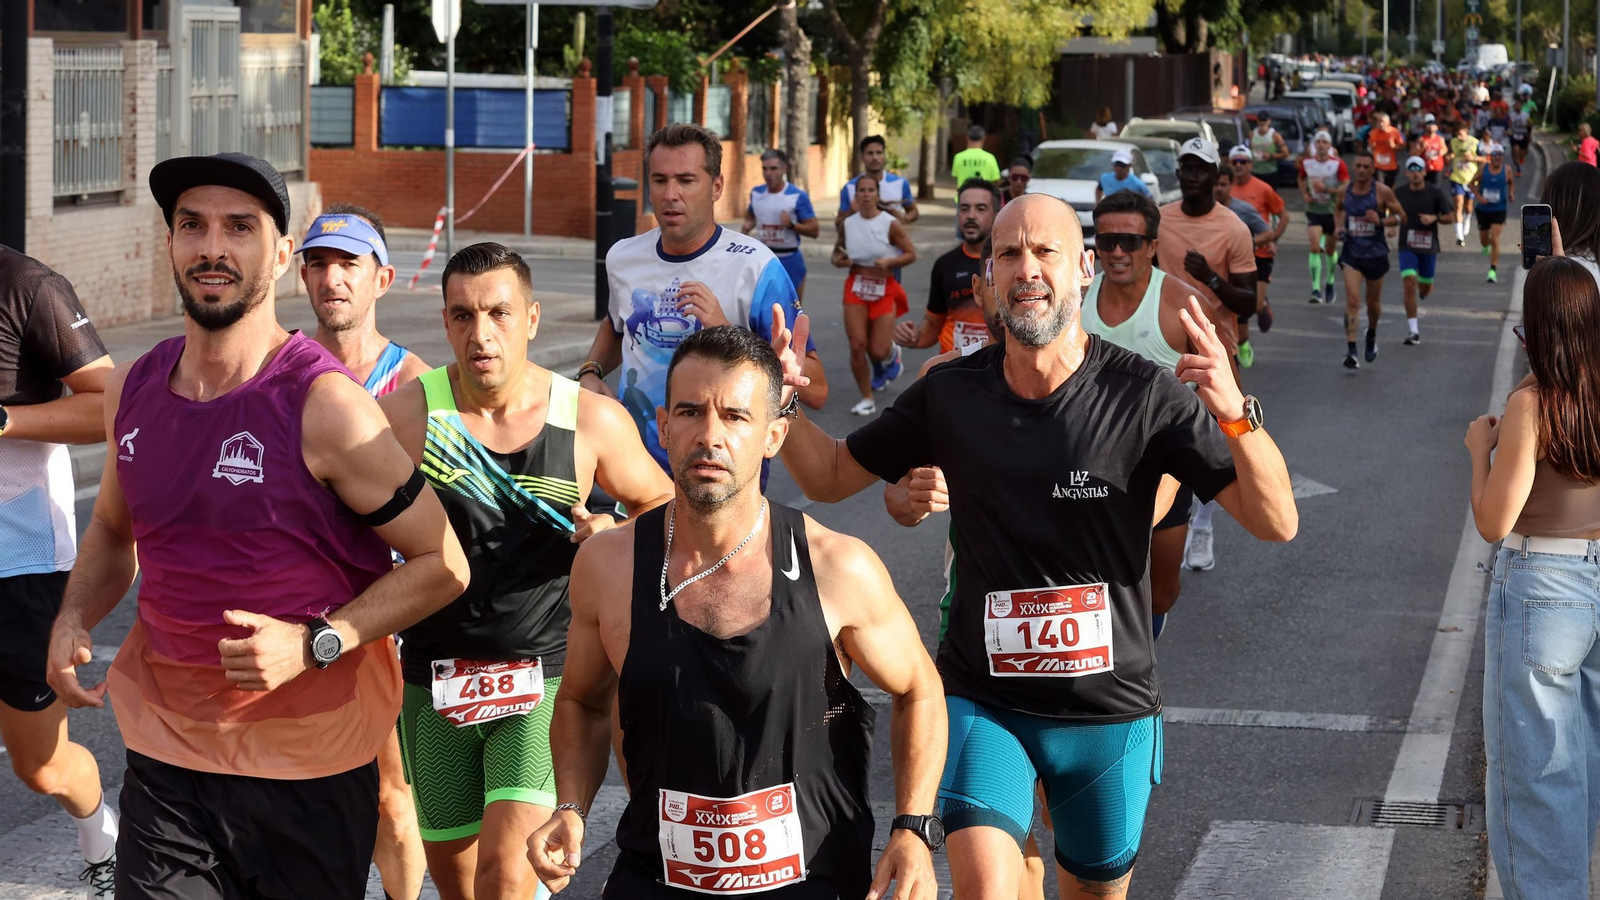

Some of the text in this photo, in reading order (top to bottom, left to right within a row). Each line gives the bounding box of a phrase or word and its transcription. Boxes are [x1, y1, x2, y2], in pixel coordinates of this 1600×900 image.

[725, 242, 757, 255] 2023
[1070, 469, 1090, 487] LAZ
[1052, 482, 1109, 500] ANGVSTIAS
[1017, 617, 1080, 649] 140
[459, 674, 514, 699] 488
[692, 828, 767, 863] 508
